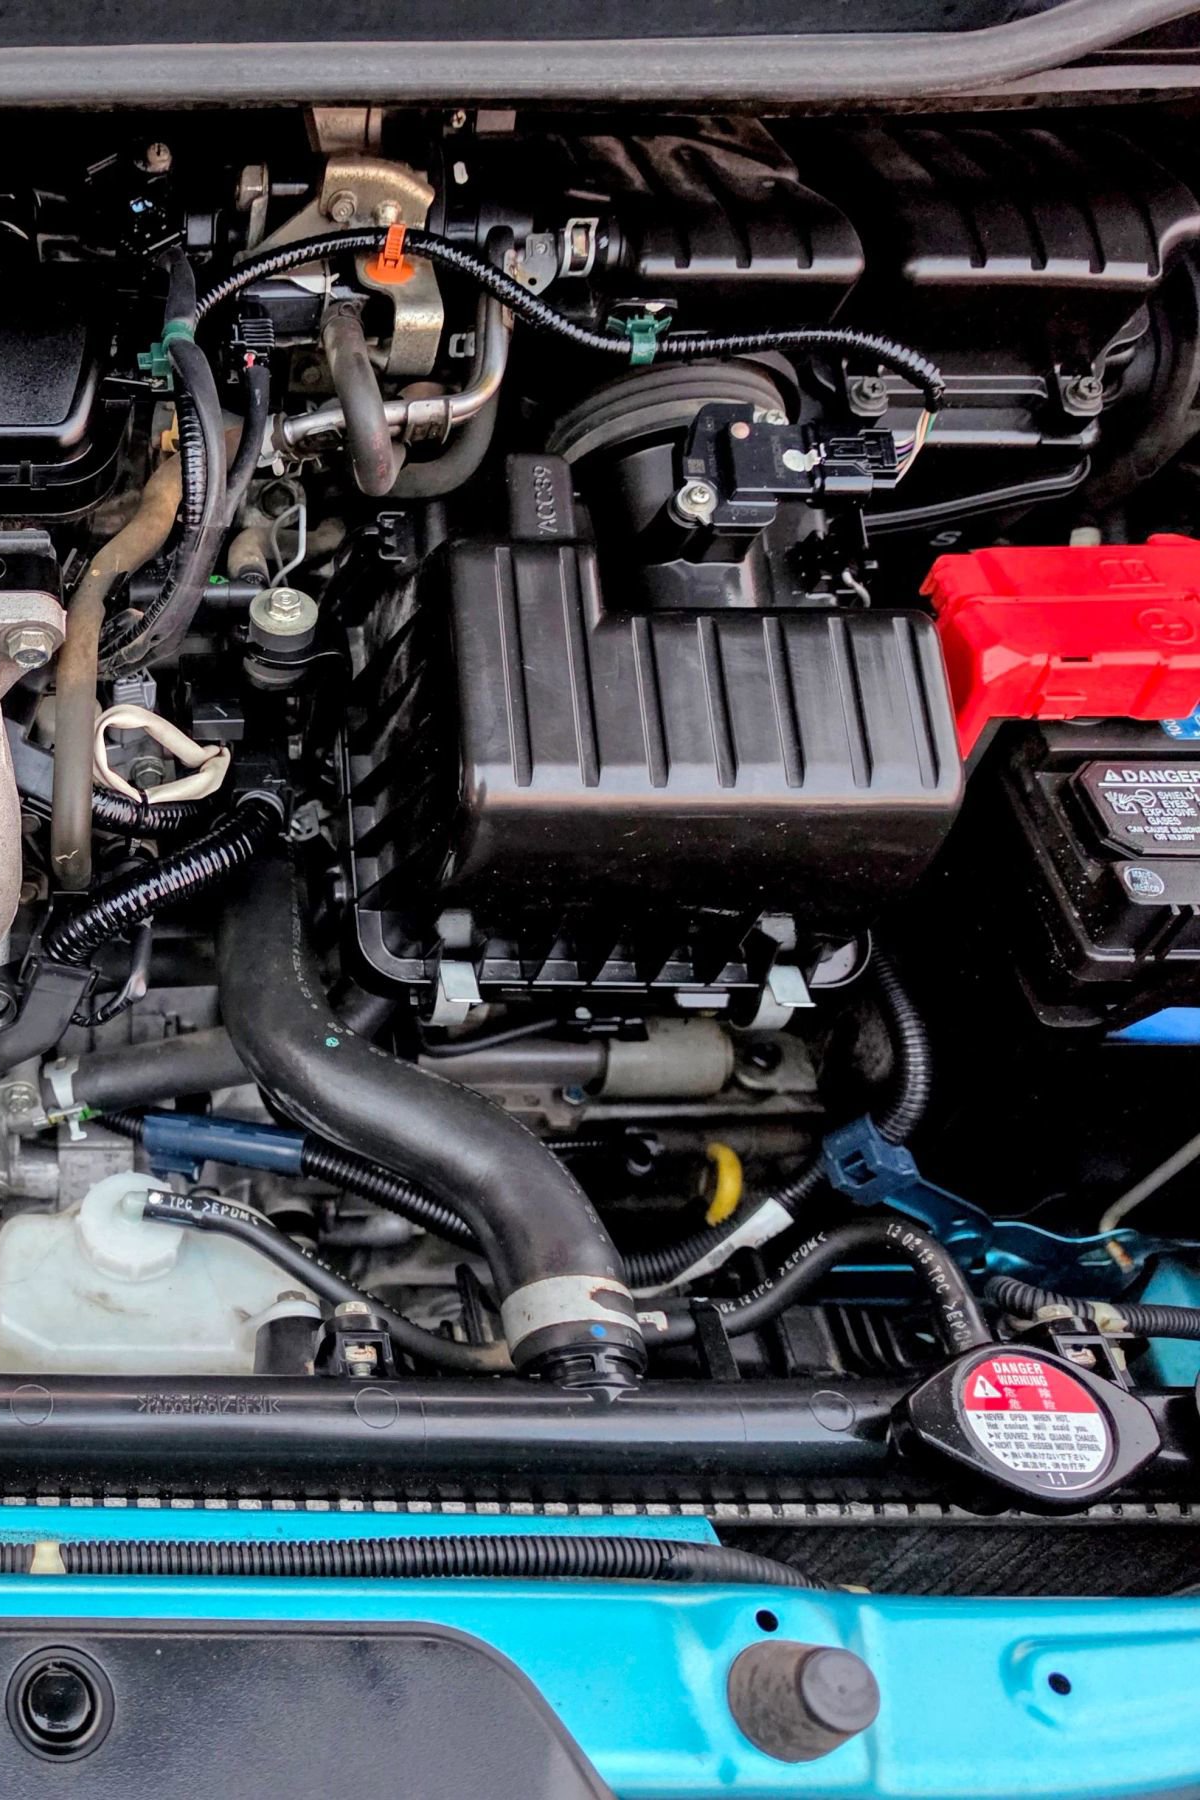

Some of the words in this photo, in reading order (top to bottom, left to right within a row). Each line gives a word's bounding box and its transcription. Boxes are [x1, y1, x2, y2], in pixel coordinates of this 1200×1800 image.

[1121, 769, 1200, 783] DANGER
[1157, 791, 1194, 800] SHIELD
[1161, 800, 1189, 808] EYES
[1141, 808, 1198, 817] EXPLOSIVE
[991, 1361, 1043, 1374] DANGER
[983, 1413, 1005, 1421] NEVER
[1009, 1413, 1028, 1421] OPEN
[1032, 1414, 1052, 1422] WHEN
[1047, 1472, 1067, 1486] 1.1
